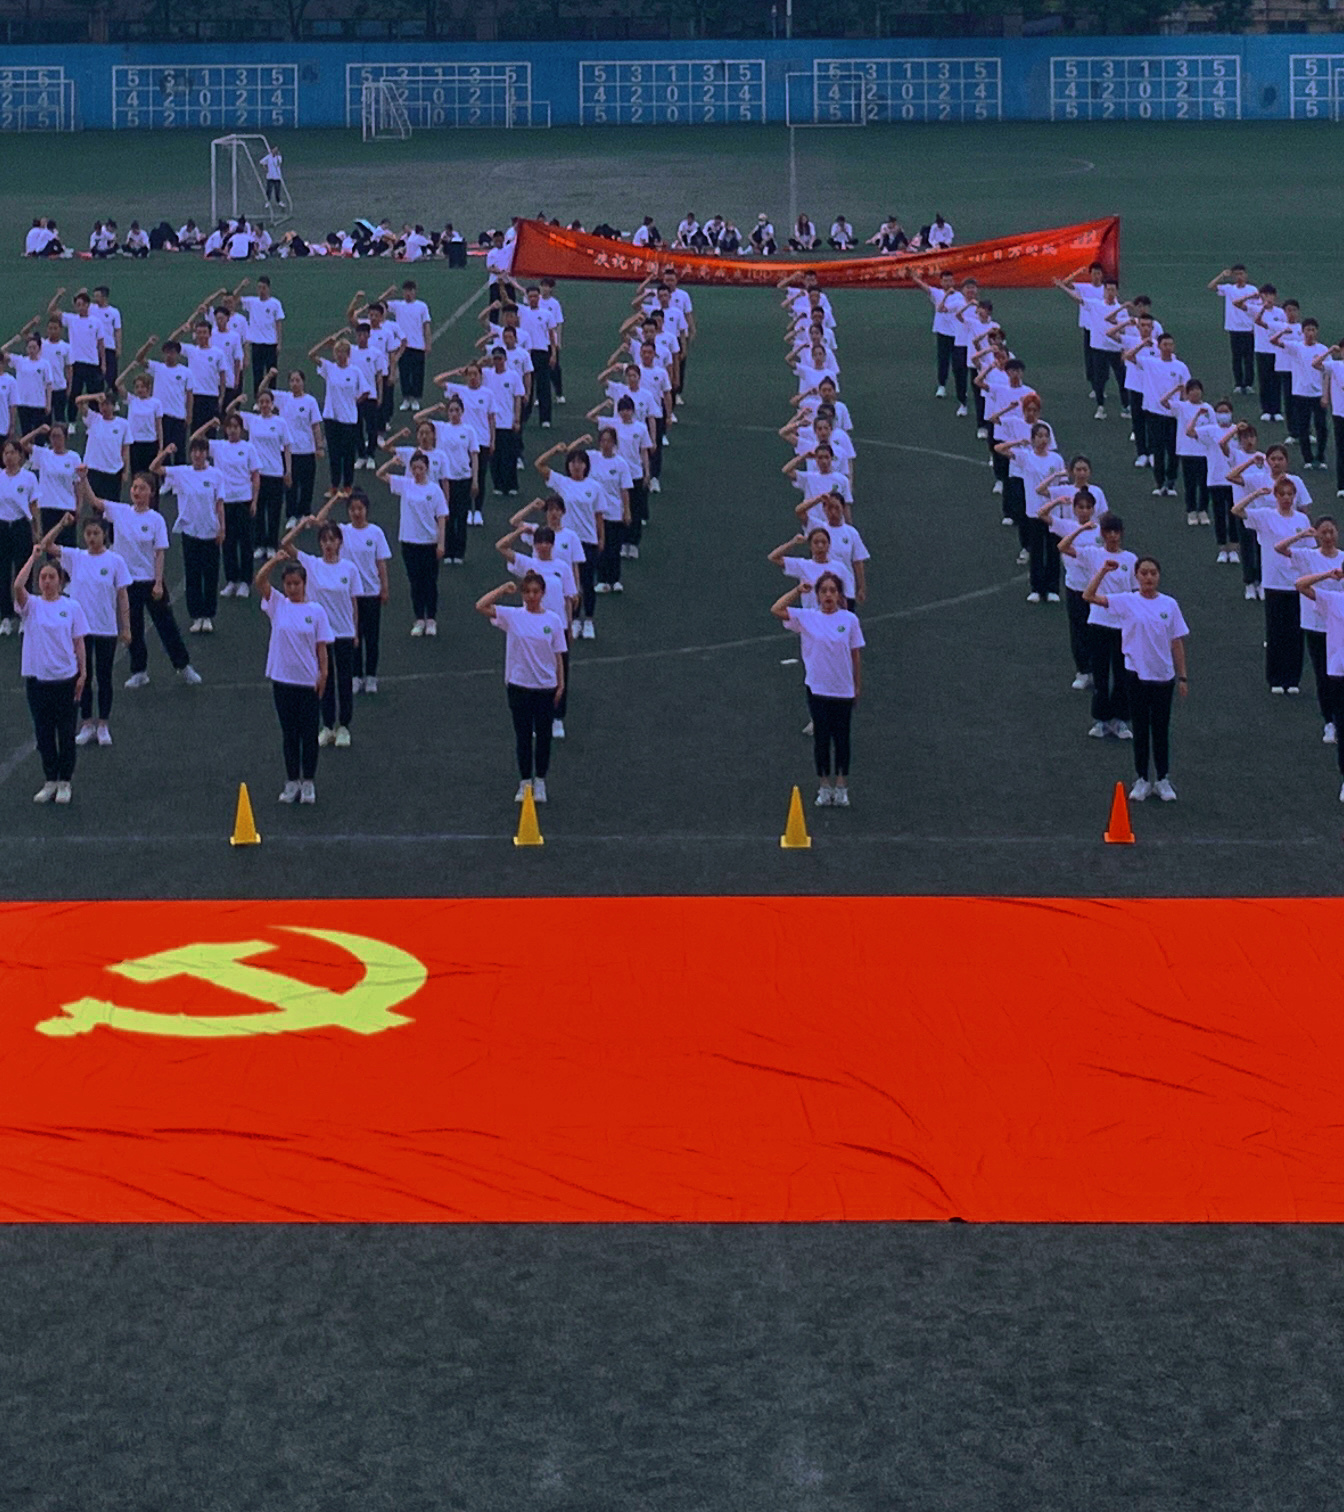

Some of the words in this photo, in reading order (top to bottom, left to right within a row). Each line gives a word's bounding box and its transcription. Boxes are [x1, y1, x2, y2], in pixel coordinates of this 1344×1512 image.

[594, 66, 606, 82] 5
[631, 65, 642, 82] 3
[668, 65, 676, 81] 1
[703, 65, 715, 81] 3
[739, 65, 751, 81] 5
[866, 63, 878, 79] 3
[903, 63, 912, 79] 1
[939, 63, 950, 79] 3
[974, 62, 986, 78] 5
[1065, 61, 1078, 78] 5
[1102, 61, 1114, 77] 3
[1140, 61, 1149, 77] 1
[1176, 61, 1188, 77] 3
[1213, 61, 1225, 76] 5
[1305, 59, 1318, 75] 5
[127, 71, 139, 86] 5
[201, 70, 209, 86] 1
[236, 70, 247, 86] 3
[271, 69, 283, 85] 5
[433, 88, 445, 104] 0
[469, 88, 481, 103] 2
[594, 86, 606, 102] 4
[631, 86, 642, 102] 2
[667, 86, 678, 102] 0
[703, 85, 715, 101] 2
[739, 85, 751, 101] 4
[828, 84, 841, 100] 4
[866, 84, 878, 100] 2
[902, 84, 913, 99] 0
[939, 83, 950, 99] 2
[974, 83, 986, 99] 4
[1065, 82, 1078, 98] 4
[1102, 82, 1114, 98] 2
[1138, 81, 1151, 98] 0
[1176, 81, 1188, 97] 2
[1213, 81, 1225, 97] 4
[1305, 80, 1318, 96] 4
[2, 92, 13, 108] 2
[38, 92, 49, 107] 4
[127, 91, 139, 105] 4
[164, 90, 175, 105] 2
[199, 90, 211, 105] 0
[236, 90, 247, 105] 2
[271, 90, 283, 105] 4
[433, 108, 445, 125] 0
[469, 108, 481, 124] 2
[594, 107, 606, 123] 5
[631, 107, 642, 122] 2
[667, 106, 678, 122] 0
[703, 106, 715, 121] 2
[739, 105, 751, 120] 5
[828, 105, 841, 120] 5
[866, 104, 878, 120] 2
[902, 104, 913, 120] 0
[939, 104, 950, 119] 2
[974, 104, 986, 119] 5
[1065, 102, 1078, 119] 5
[1102, 102, 1114, 118] 2
[1138, 102, 1151, 118] 0
[1176, 102, 1188, 118] 2
[1213, 102, 1225, 117] 5
[1305, 101, 1318, 117] 5
[2, 112, 13, 128] 2
[38, 112, 49, 127] 5
[127, 111, 139, 127] 5
[164, 111, 175, 126] 2
[199, 110, 211, 126] 0
[236, 110, 247, 126] 2
[271, 110, 283, 125] 5
